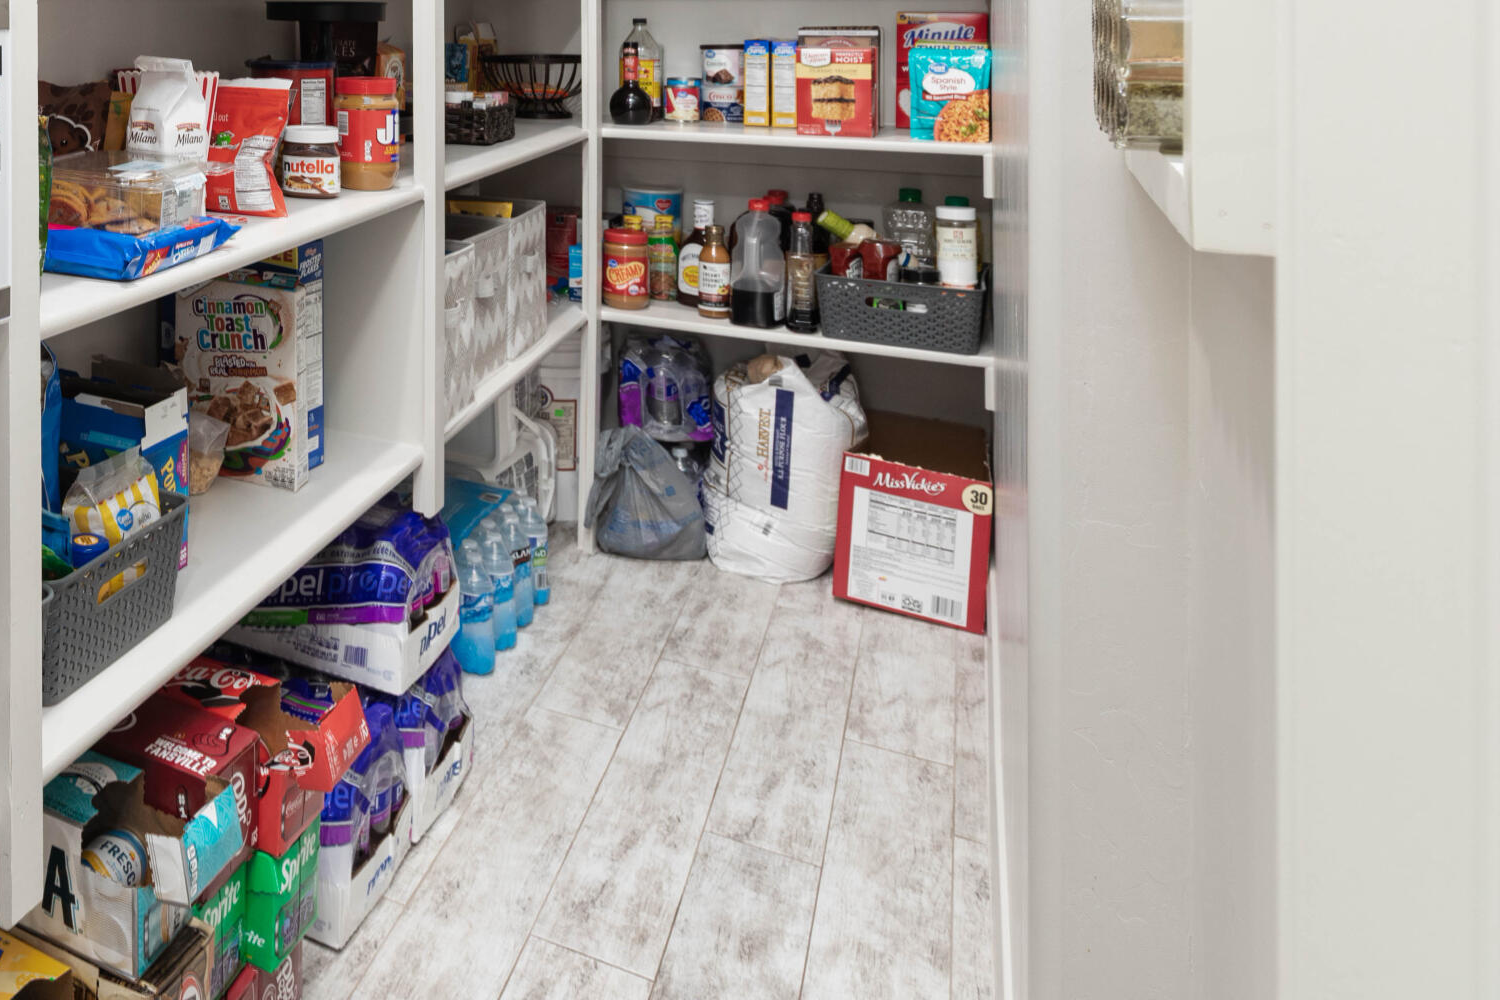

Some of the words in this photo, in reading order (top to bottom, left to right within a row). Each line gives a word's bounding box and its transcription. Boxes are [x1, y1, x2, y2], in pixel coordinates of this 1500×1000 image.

[904, 26, 975, 47] Minute
[835, 56, 864, 64] MOIST
[931, 76, 967, 87] Spanish
[940, 83, 958, 92] Style
[128, 131, 157, 145] Milano
[175, 132, 204, 147] Milano
[283, 159, 335, 175] nutella
[299, 253, 322, 271] FROSTED
[300, 264, 320, 278] FLAKES
[608, 262, 644, 283] CREAMY
[193, 296, 266, 315] Cinnamon
[207, 314, 252, 332] Toast
[199, 328, 267, 350] Crunch
[214, 355, 246, 368] BLASTED
[210, 367, 229, 376] REAL
[756, 407, 772, 458] HARVEST
[779, 416, 788, 440] FLOUR
[873, 471, 904, 489] Miss
[901, 471, 948, 496] Vickie's
[970, 489, 988, 506] 30
[144, 744, 213, 777] FANSVILLE
[153, 737, 204, 763] WELCOME
[201, 755, 218, 769] TO
[100, 839, 136, 887] FRESC
[280, 832, 316, 895] Sprite
[204, 880, 241, 928] Sprite
